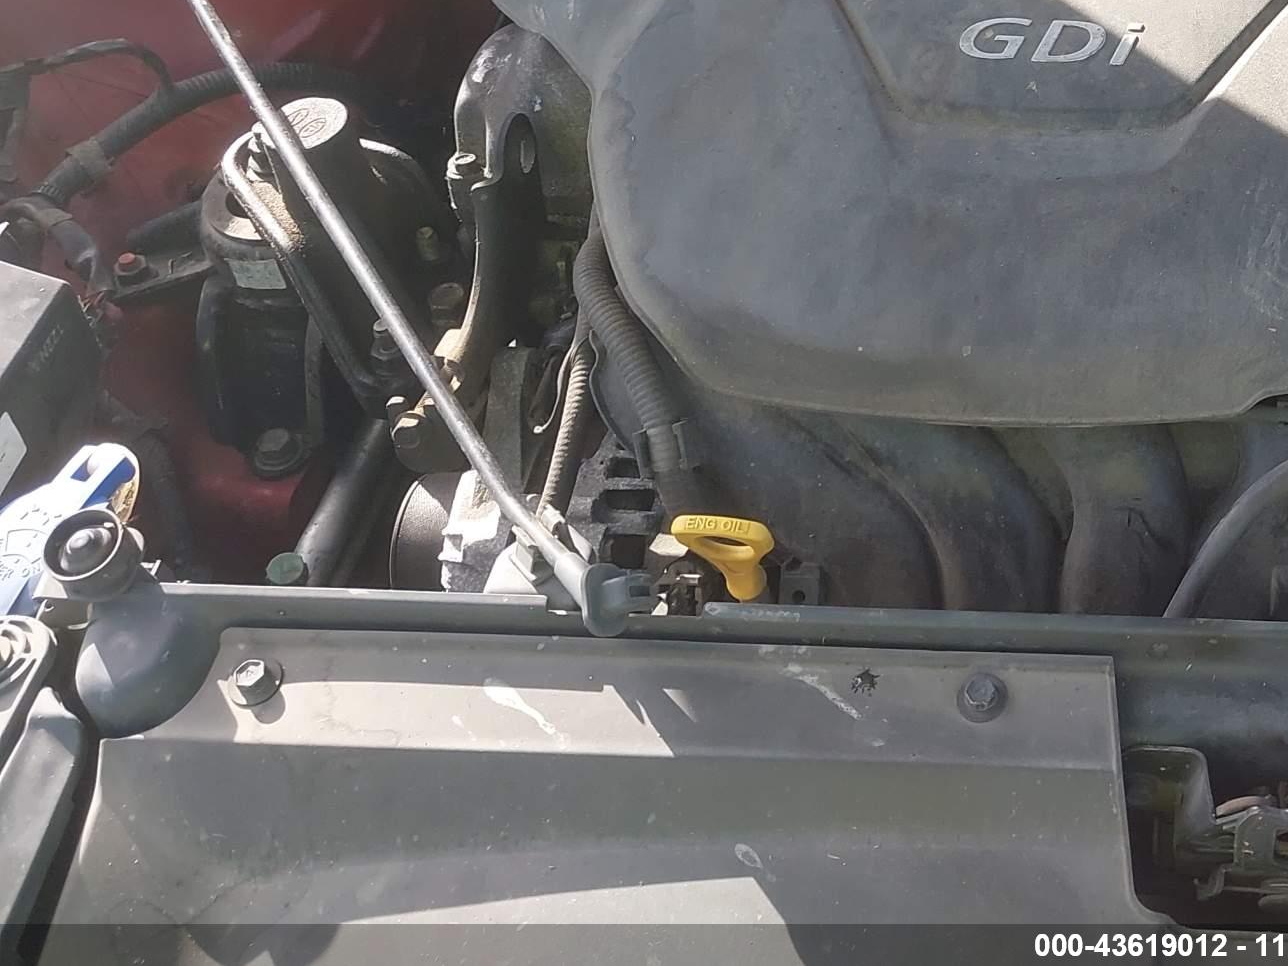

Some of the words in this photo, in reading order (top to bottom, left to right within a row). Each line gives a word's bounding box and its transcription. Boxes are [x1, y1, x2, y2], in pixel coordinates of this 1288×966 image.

[959, 17, 1146, 66] GDi
[685, 516, 717, 531] ENG
[721, 520, 745, 533] OIL
